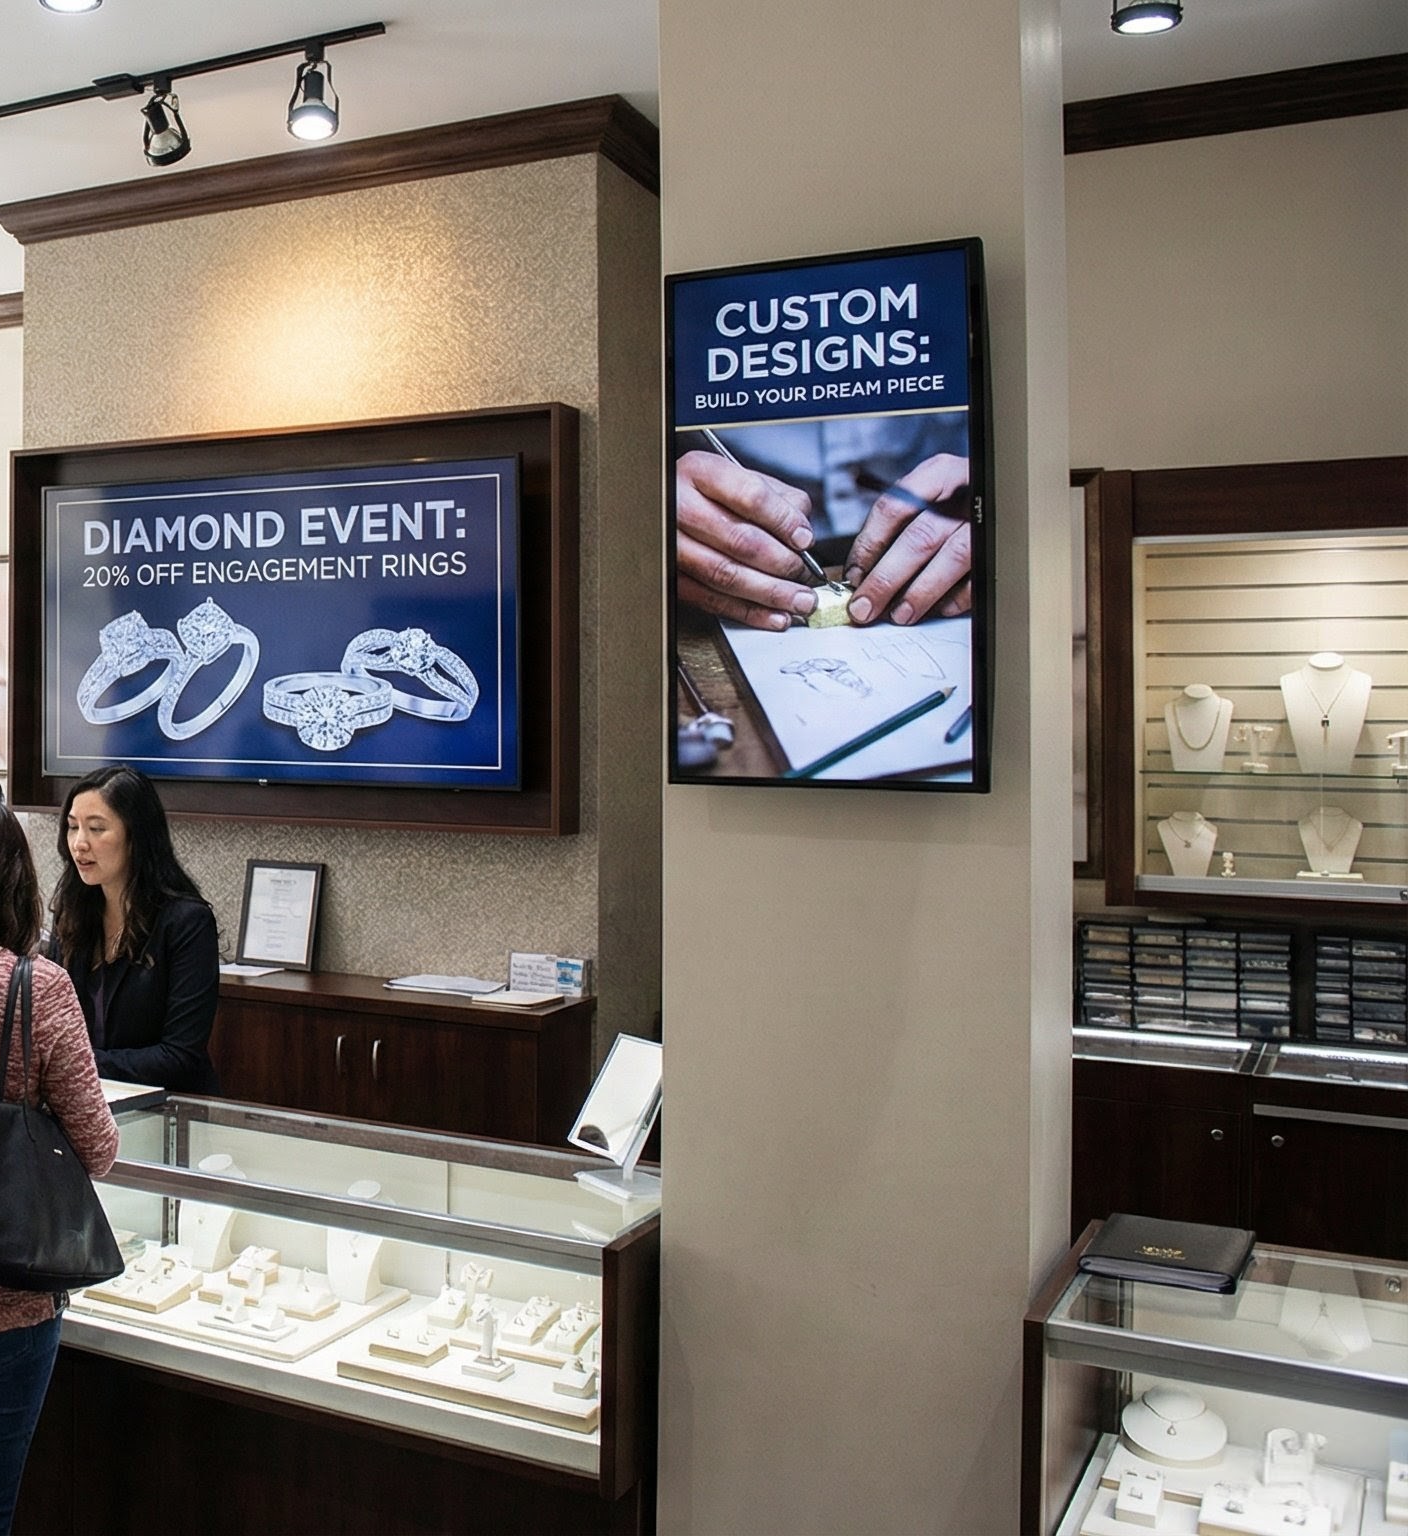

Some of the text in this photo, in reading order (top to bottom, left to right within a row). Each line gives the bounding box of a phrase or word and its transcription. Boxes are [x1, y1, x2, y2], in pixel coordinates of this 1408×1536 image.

[715, 283, 918, 337] CUSTOM
[707, 329, 930, 382] DESIGNS:
[695, 375, 945, 409] BUILD YOUR DREAM PIECE
[83, 499, 466, 556] DIAMOND EVENT:
[82, 551, 467, 587] 20% OFF ENGAGEMENT RINGS
